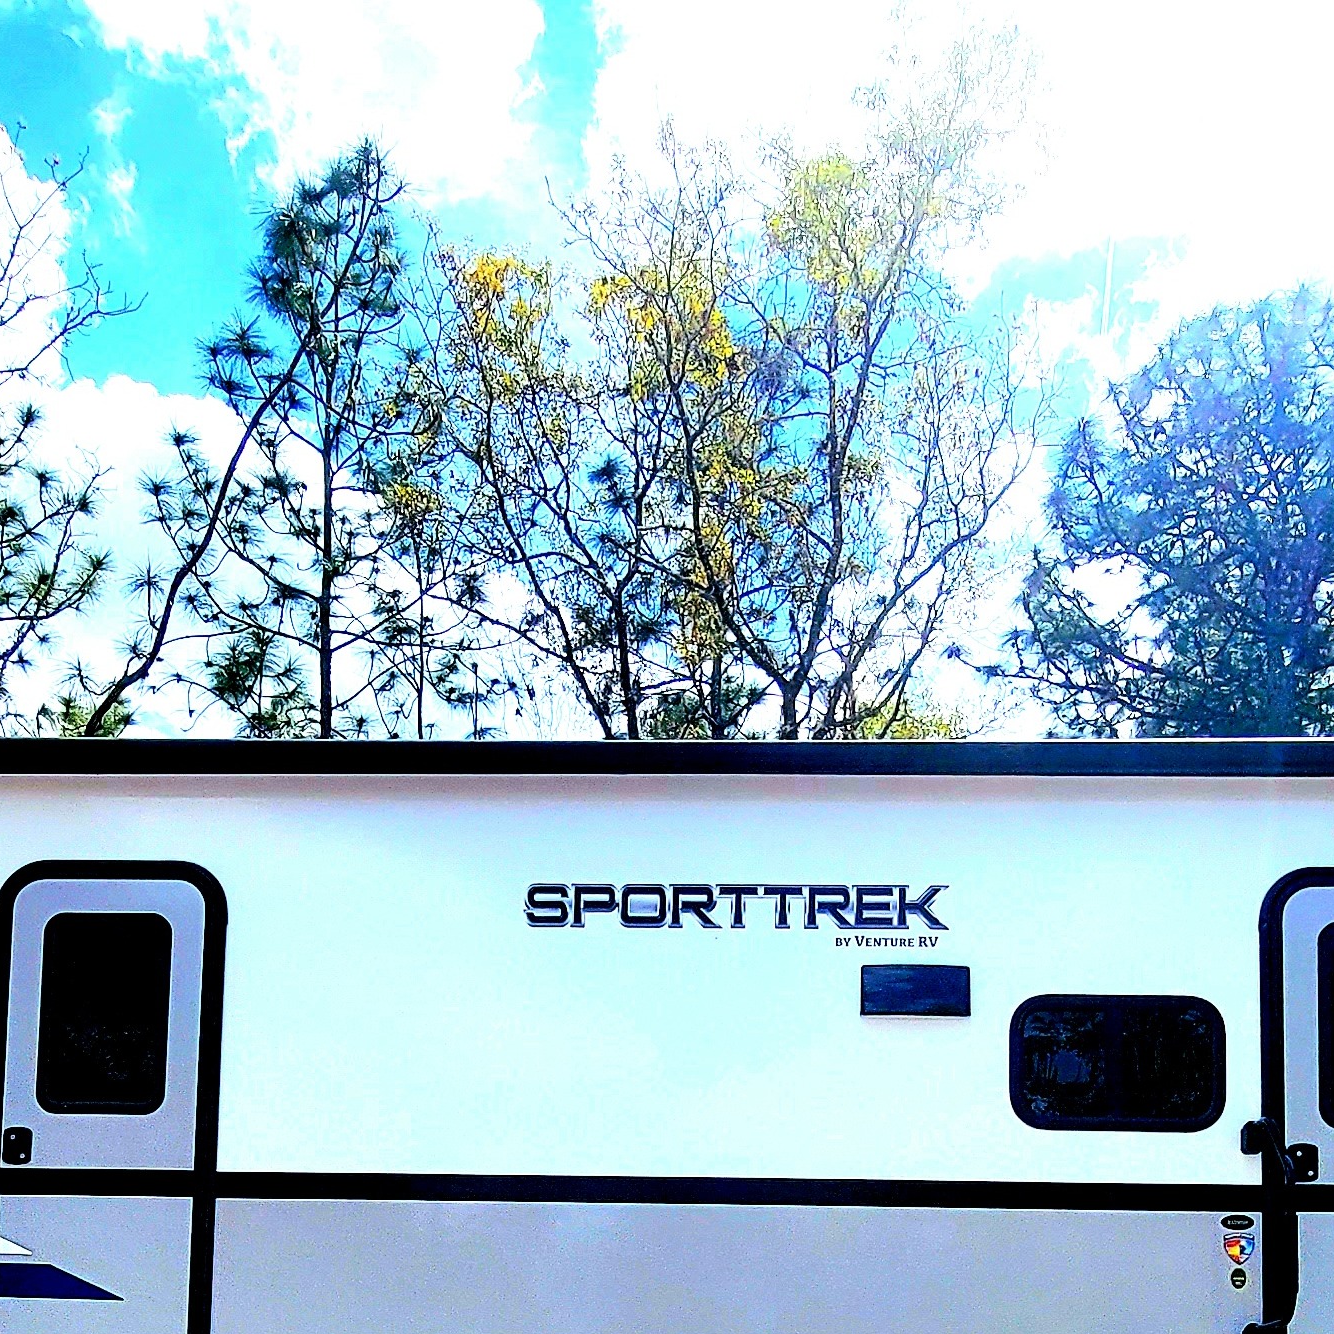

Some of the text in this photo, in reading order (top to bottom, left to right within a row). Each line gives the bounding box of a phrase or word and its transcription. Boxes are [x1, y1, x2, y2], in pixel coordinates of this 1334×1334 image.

[524, 883, 950, 931] SPORTTREK
[835, 935, 939, 948] BY VENTURE RV
